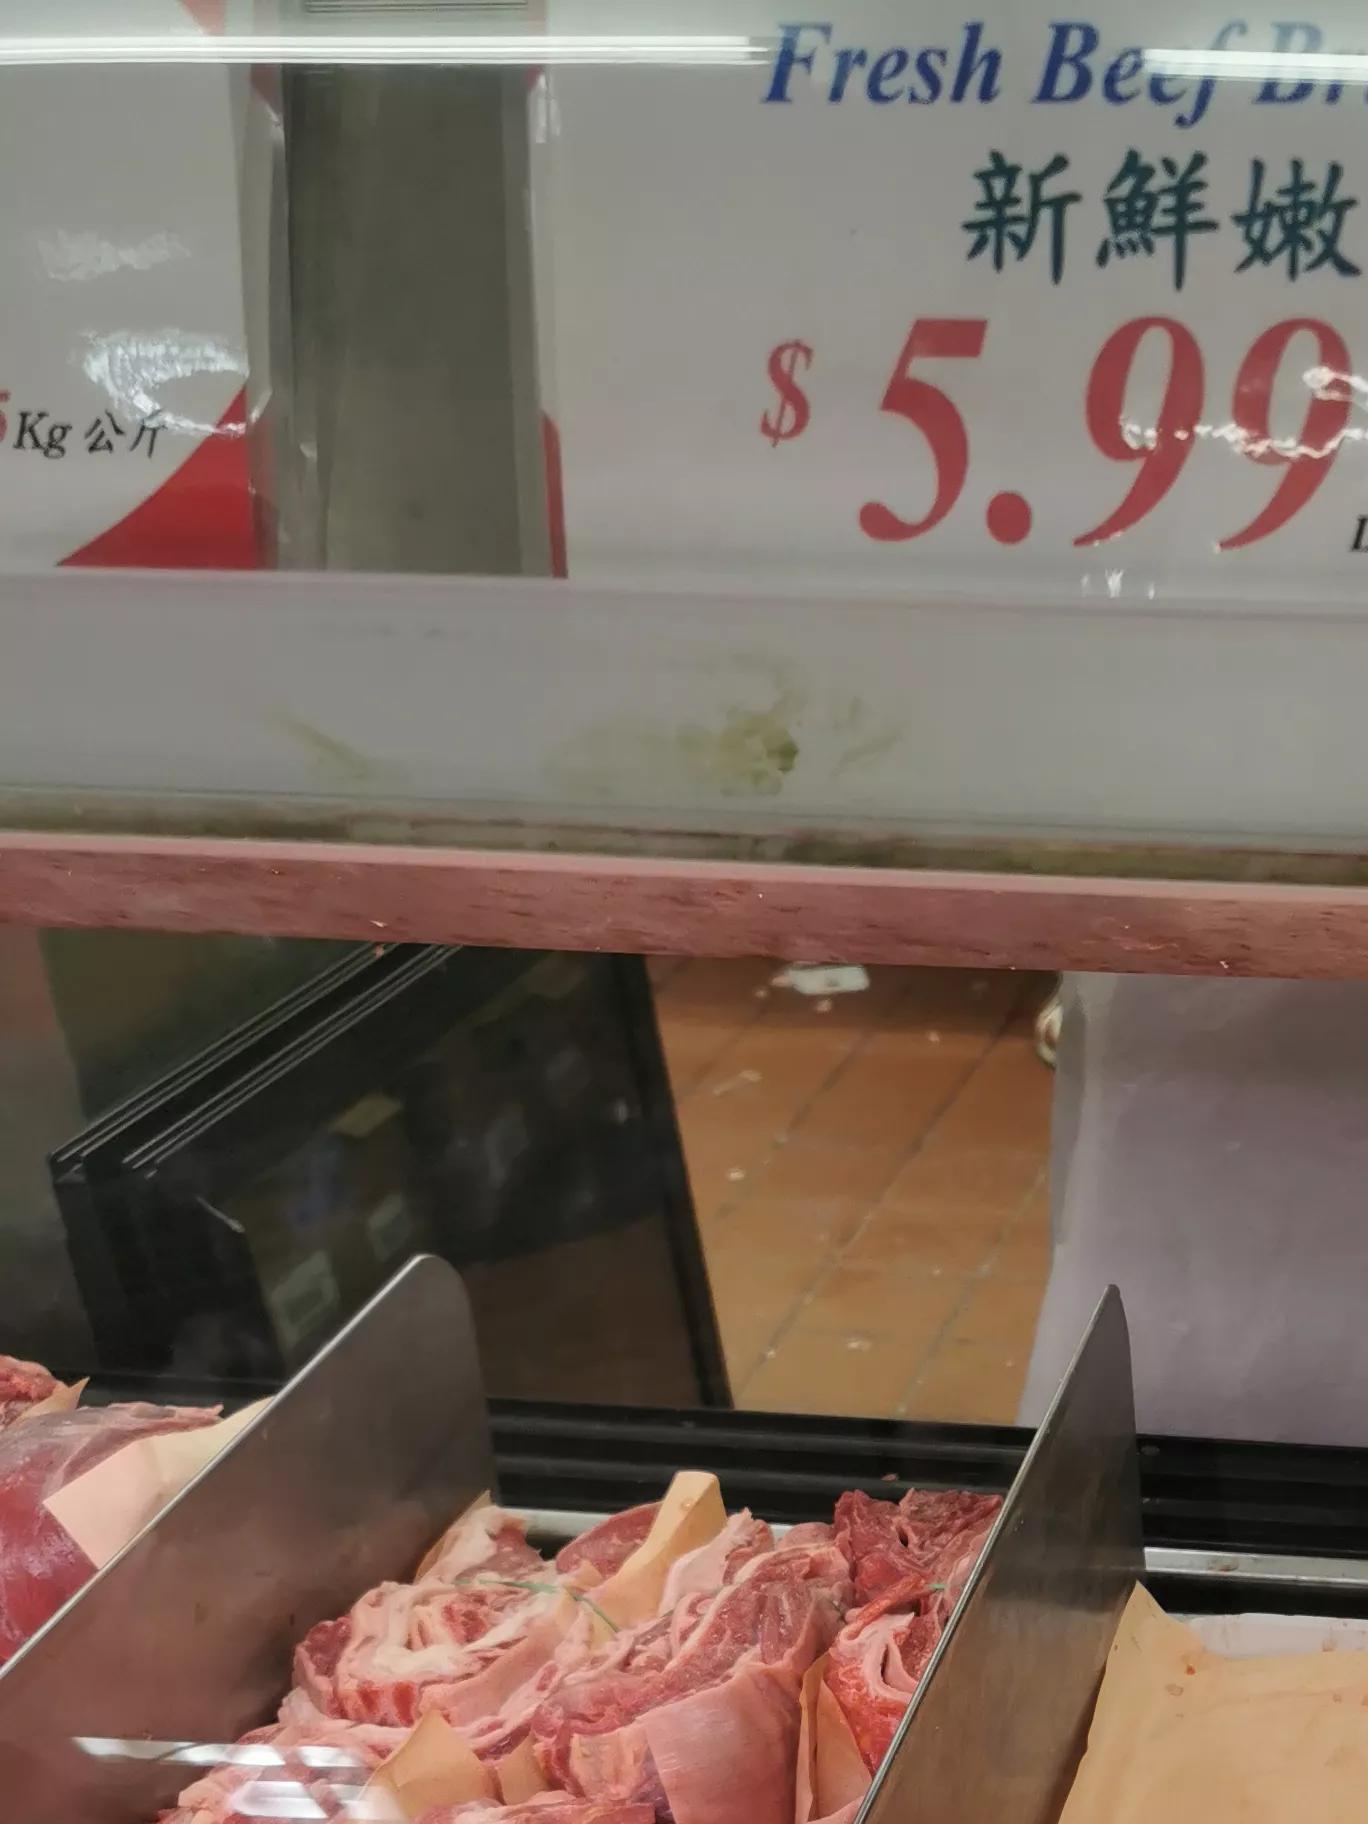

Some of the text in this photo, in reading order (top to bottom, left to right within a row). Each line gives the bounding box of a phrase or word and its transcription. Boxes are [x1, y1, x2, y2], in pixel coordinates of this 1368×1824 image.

[762, 20, 1001, 104] Fresh
[1031, 18, 1247, 128] Beef
[12, 410, 73, 460] Kg
